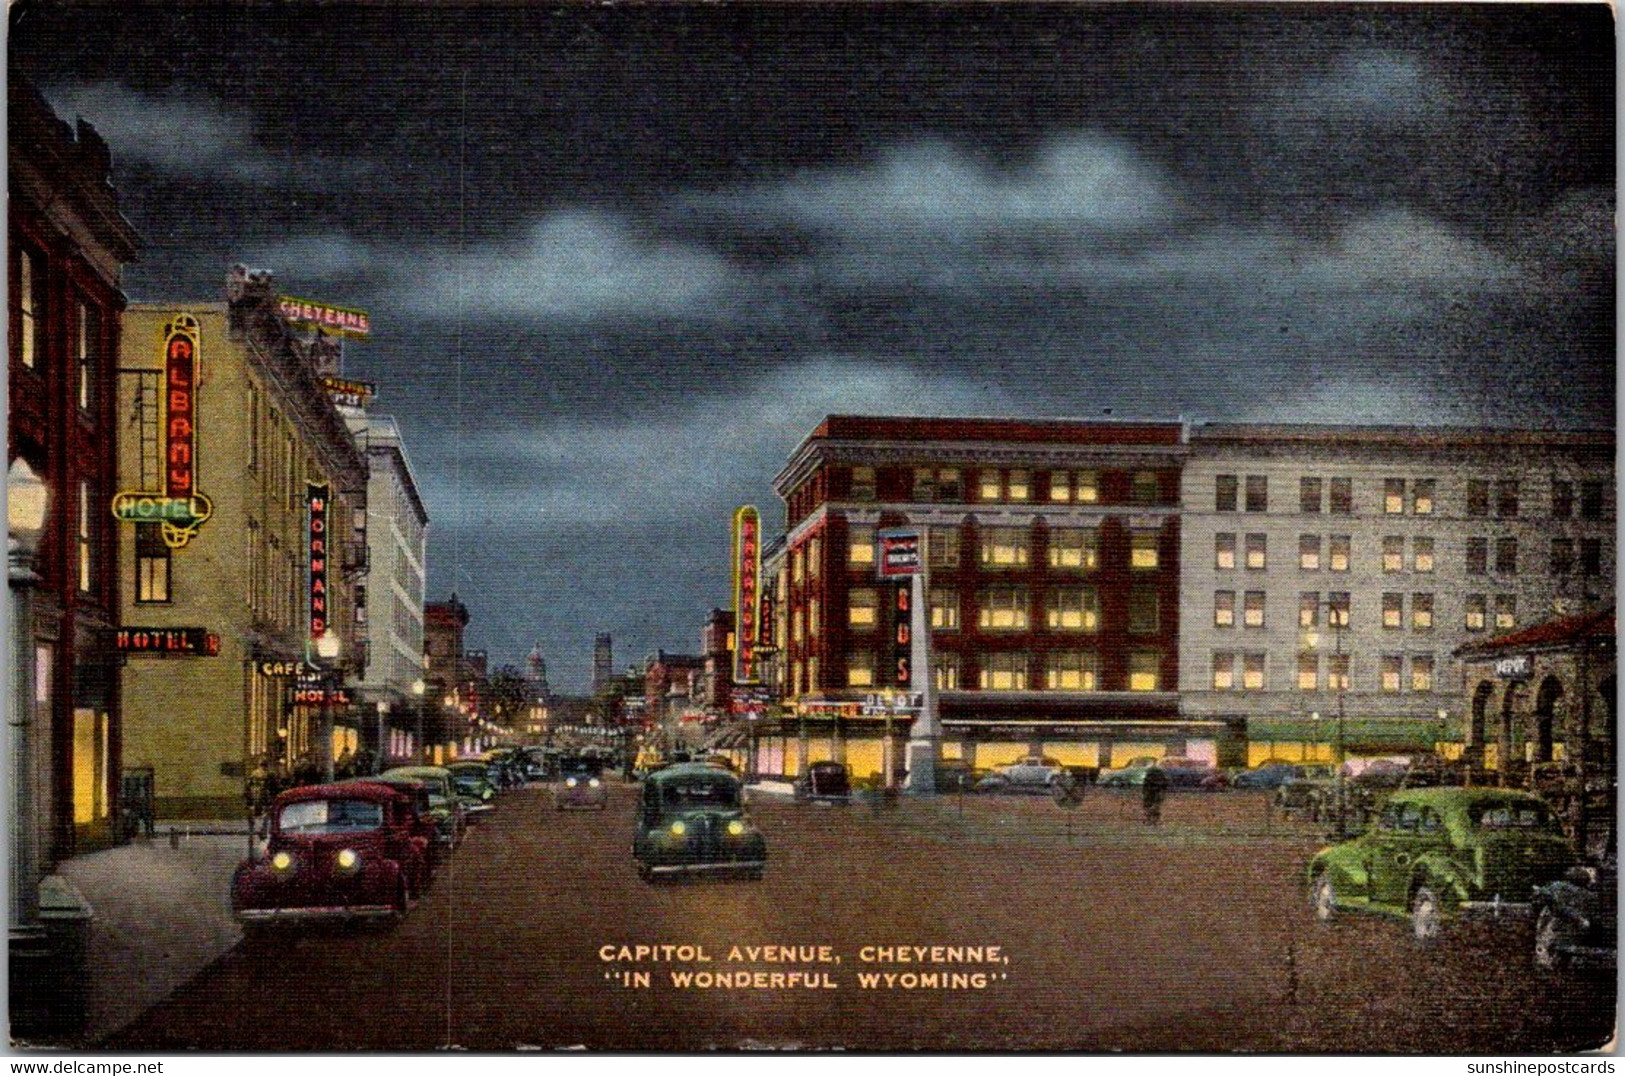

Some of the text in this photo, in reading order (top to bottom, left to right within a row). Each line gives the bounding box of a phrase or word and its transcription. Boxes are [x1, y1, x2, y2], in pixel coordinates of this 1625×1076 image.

[280, 301, 367, 330] CHEYENNE
[169, 341, 192, 491] ALBANY
[119, 496, 206, 518] HOTEL
[311, 499, 325, 631] NORMAND
[117, 631, 194, 649] HOTEL
[262, 662, 305, 675] CAFE
